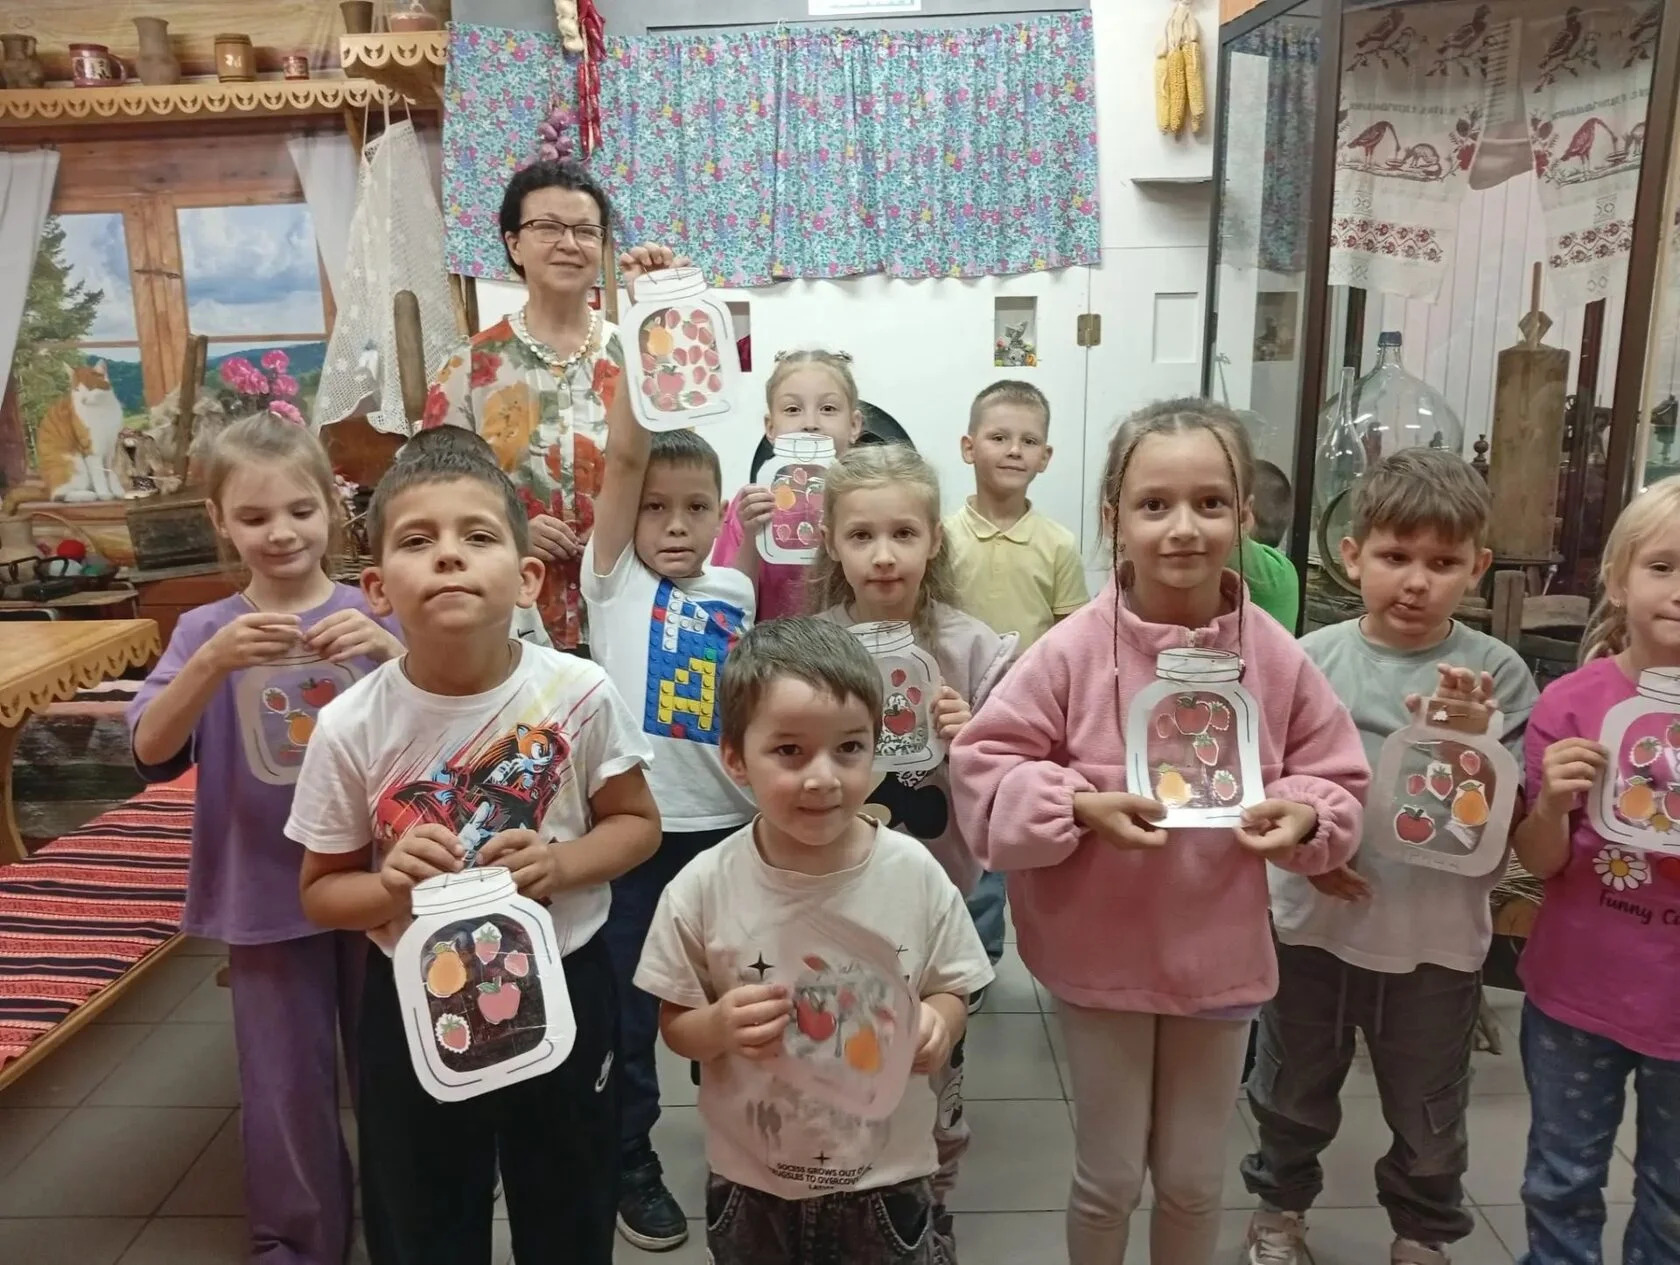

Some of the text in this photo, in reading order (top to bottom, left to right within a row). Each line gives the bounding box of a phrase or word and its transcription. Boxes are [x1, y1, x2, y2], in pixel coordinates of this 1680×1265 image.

[1600, 889, 1653, 925] Funny
[807, 1166, 837, 1177] GROWS
[838, 1169, 857, 1177] OUT
[806, 1174, 816, 1183] TO
